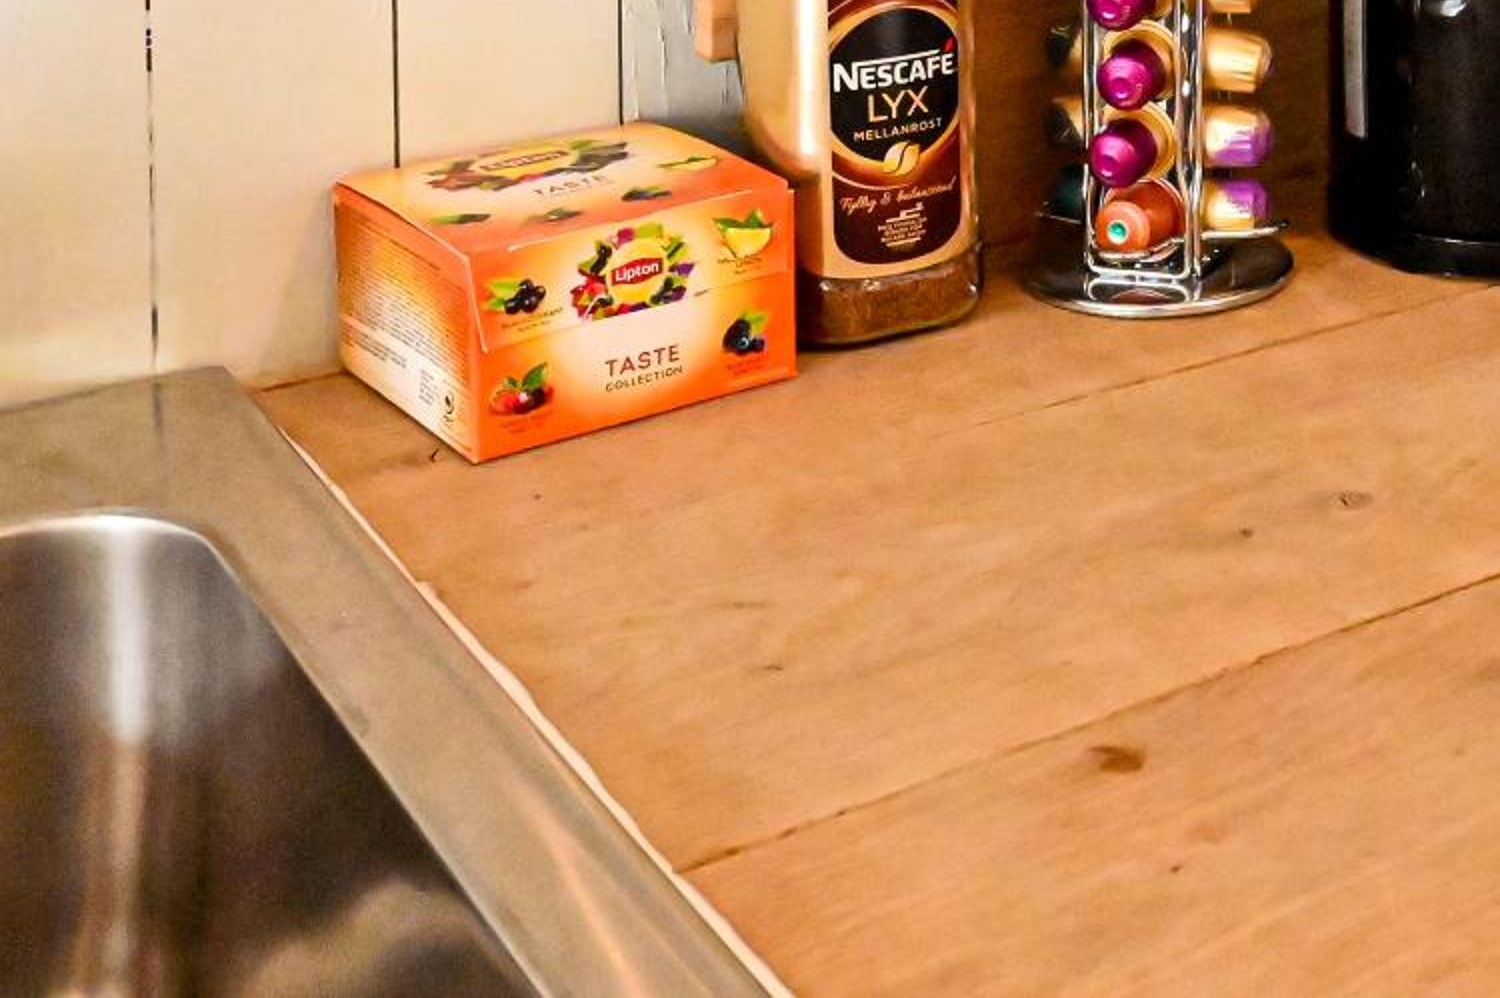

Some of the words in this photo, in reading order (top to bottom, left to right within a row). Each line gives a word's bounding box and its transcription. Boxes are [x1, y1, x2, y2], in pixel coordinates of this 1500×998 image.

[867, 85, 929, 123] LYX
[853, 117, 942, 142] MELLANROST
[615, 262, 660, 283] Lipton
[604, 344, 681, 378] TASTE
[604, 365, 684, 393] COLLECTION
